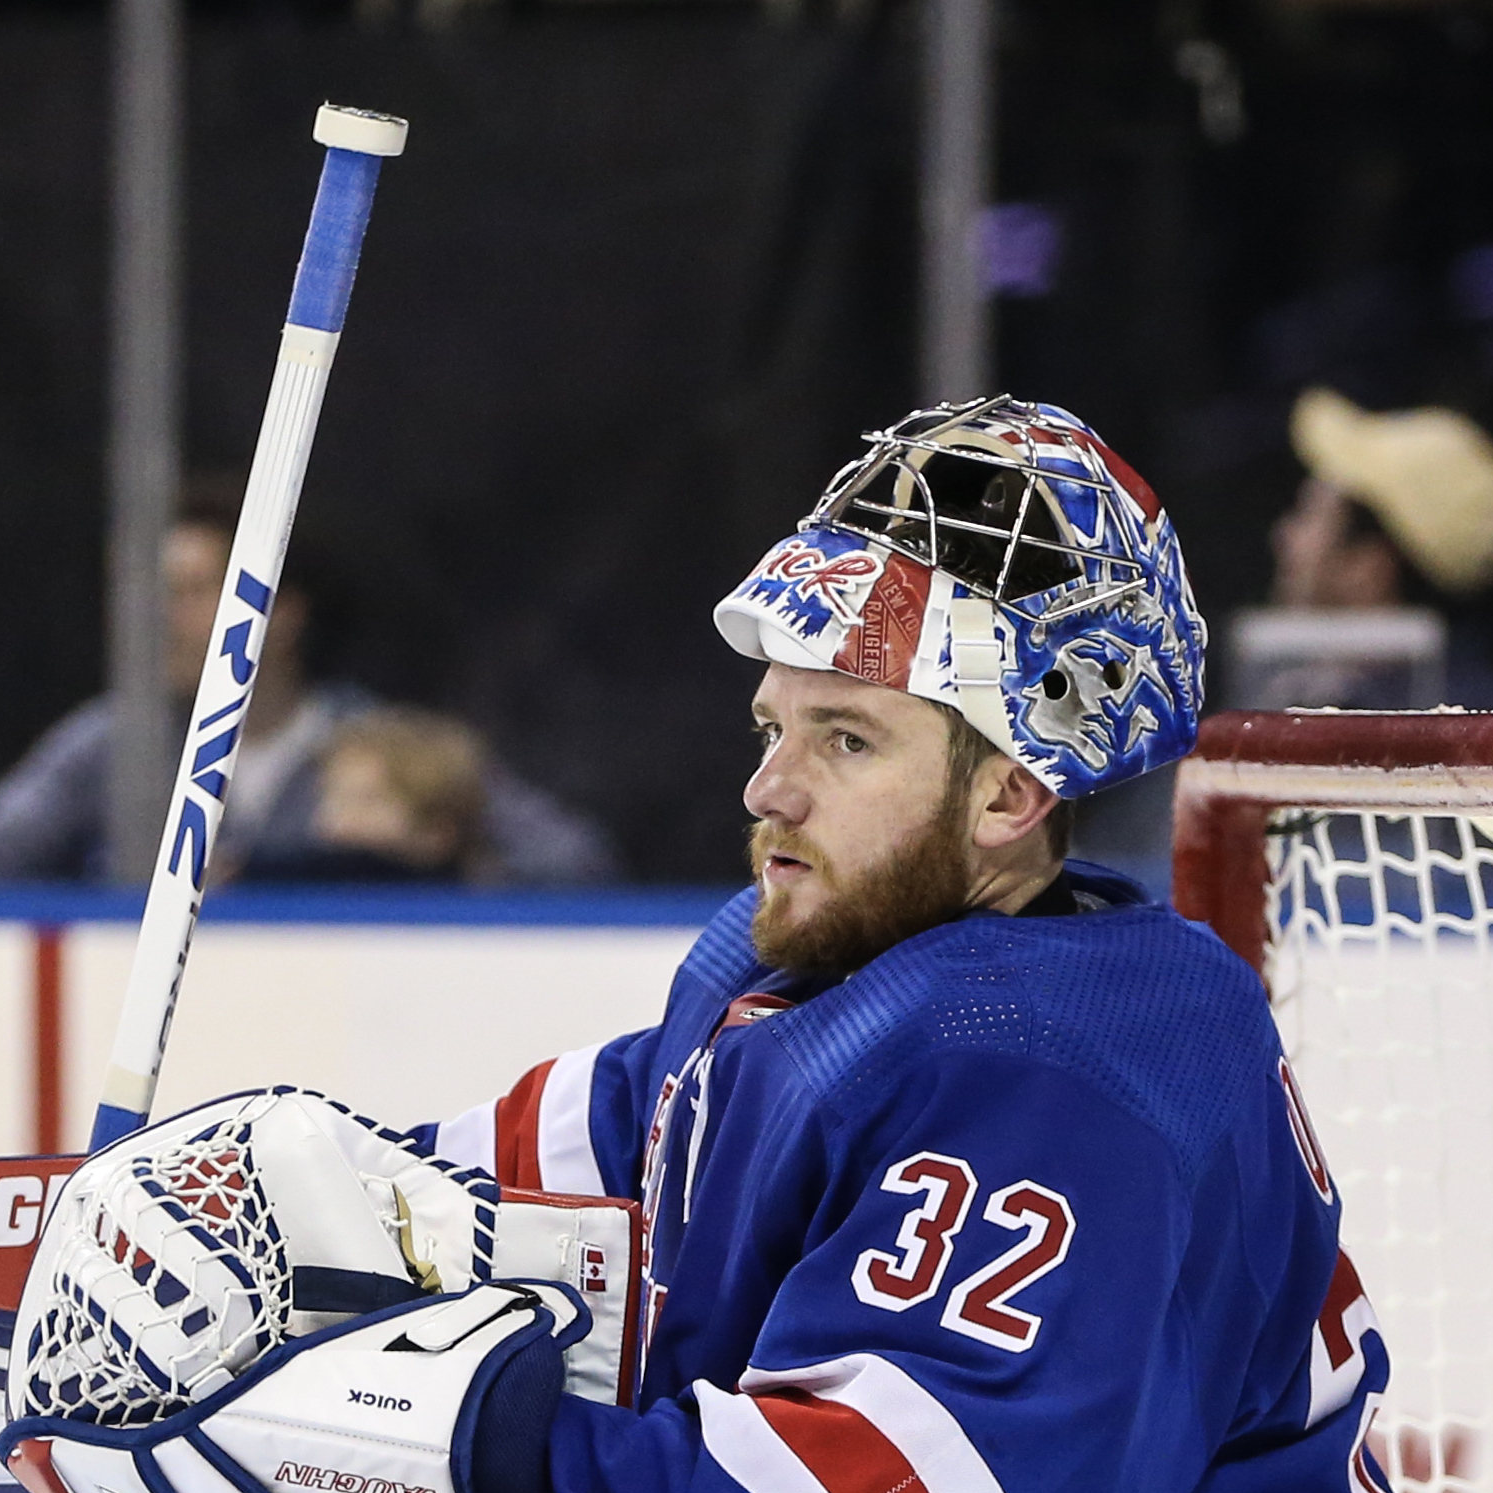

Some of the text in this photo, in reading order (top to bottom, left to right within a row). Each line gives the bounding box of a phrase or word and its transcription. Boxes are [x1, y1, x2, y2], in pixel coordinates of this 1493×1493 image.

[862, 599, 883, 682] RANGERS
[852, 1151, 1076, 1353] 32
[347, 1389, 412, 1412] QUICK
